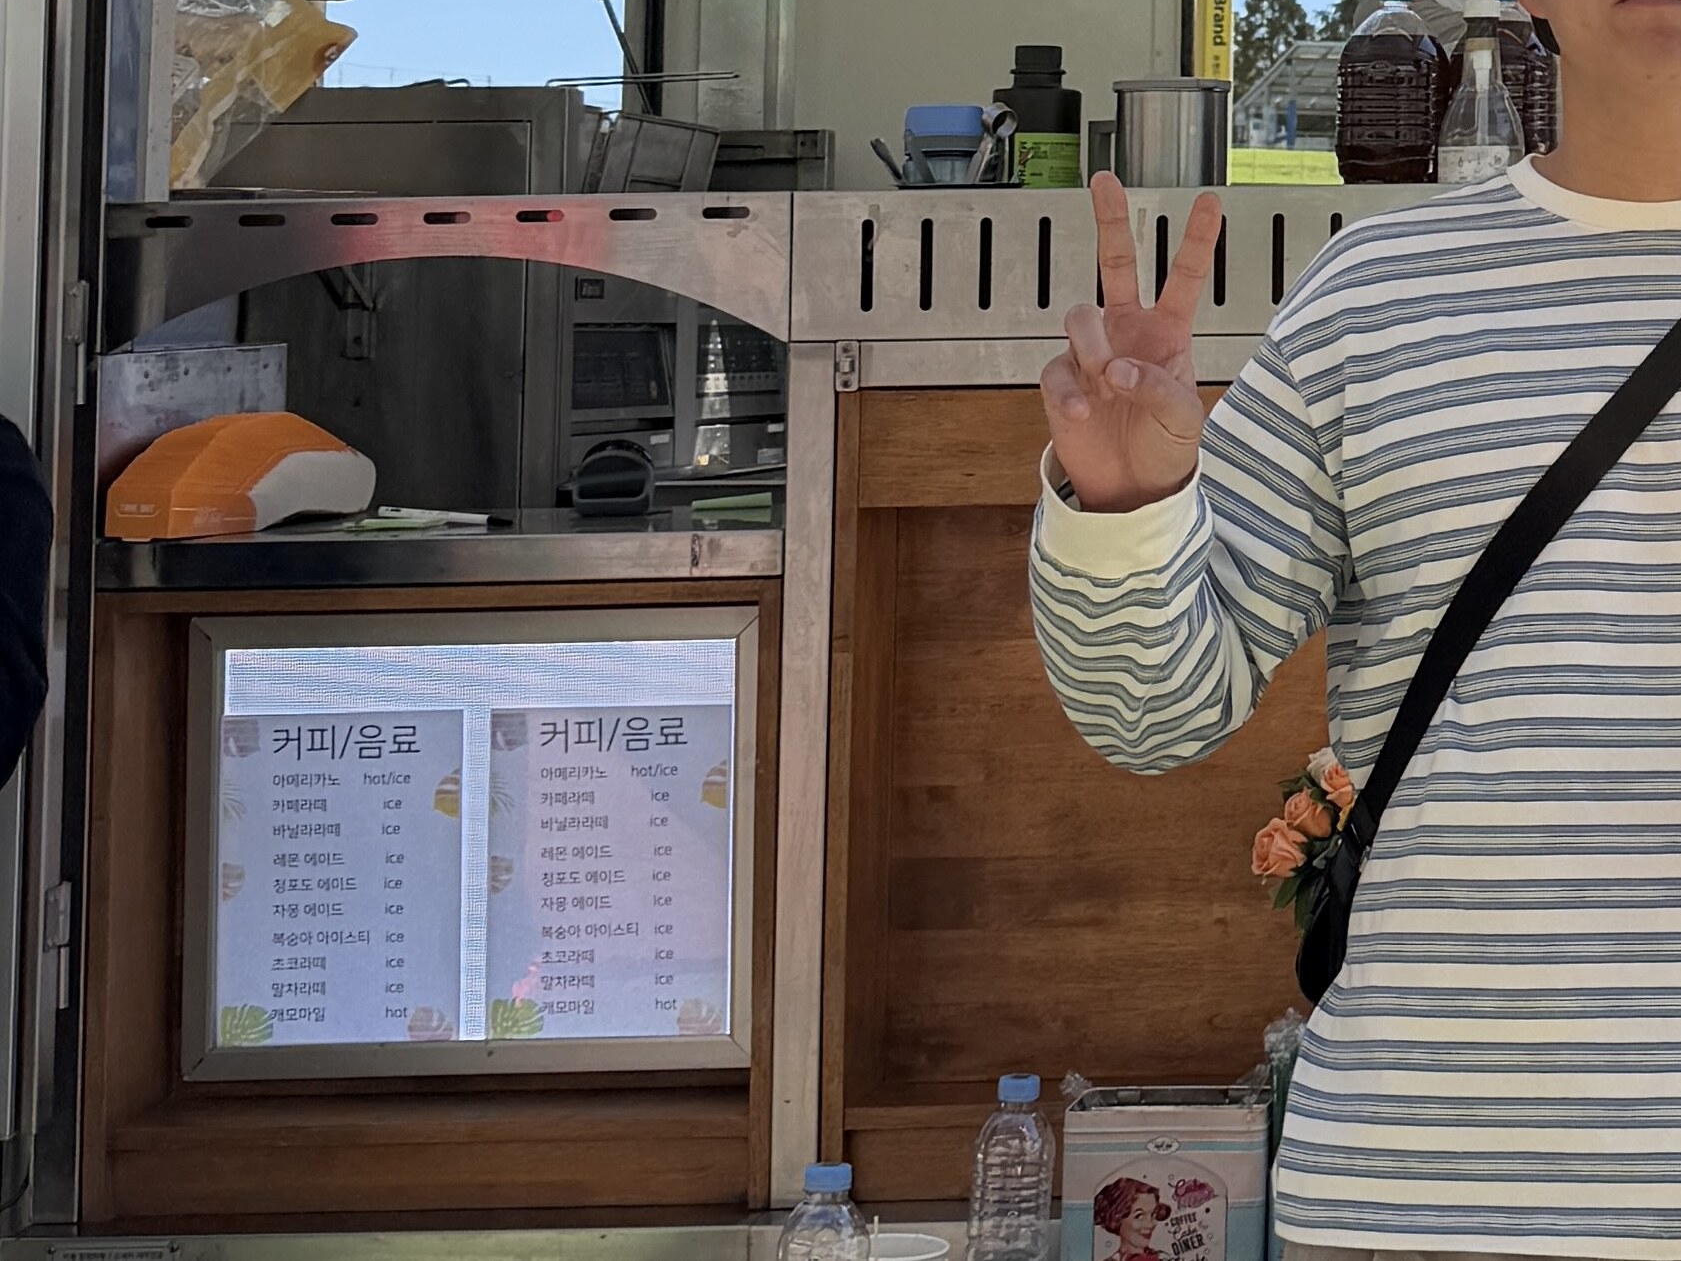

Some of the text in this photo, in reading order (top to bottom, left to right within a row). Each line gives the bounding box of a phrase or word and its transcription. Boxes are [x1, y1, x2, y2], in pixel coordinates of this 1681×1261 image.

[272, 724, 421, 761] 커피/음료
[540, 717, 688, 753] 커피/음료
[272, 772, 411, 789] 아메리카노 hot/ice
[541, 764, 678, 781] 아메리카노 hot/ice
[272, 798, 403, 813] 카페라떼 ice
[541, 790, 669, 806] 카페라떼 ice
[272, 823, 401, 839] 바닐라라떼 ice
[540, 816, 668, 832] 바닐라라떼 ice
[273, 852, 405, 868] 레몬 에이드 ice
[540, 845, 672, 861] 레몬 에이드 ice
[273, 877, 403, 894] 청포도 에이드 ice
[541, 870, 671, 887] 청포도 에이드 ice
[272, 902, 404, 918] 자몽 에이드 ice
[541, 895, 672, 912] 자몽 에이드 ice
[272, 930, 404, 947] 복숭아 아이스티 ice
[541, 922, 673, 940] 복숭아 아이스티 ice
[271, 956, 405, 971] 초코라떼 ice
[541, 948, 674, 964] 초코라떼 ice
[271, 981, 404, 998] 말차라떼 ice
[541, 974, 674, 991] 말차라떼 ice
[271, 1007, 408, 1023] 캐모마일 hot
[540, 998, 677, 1015] 캐모마일 hot
[1171, 1233, 1206, 1256] DINER
